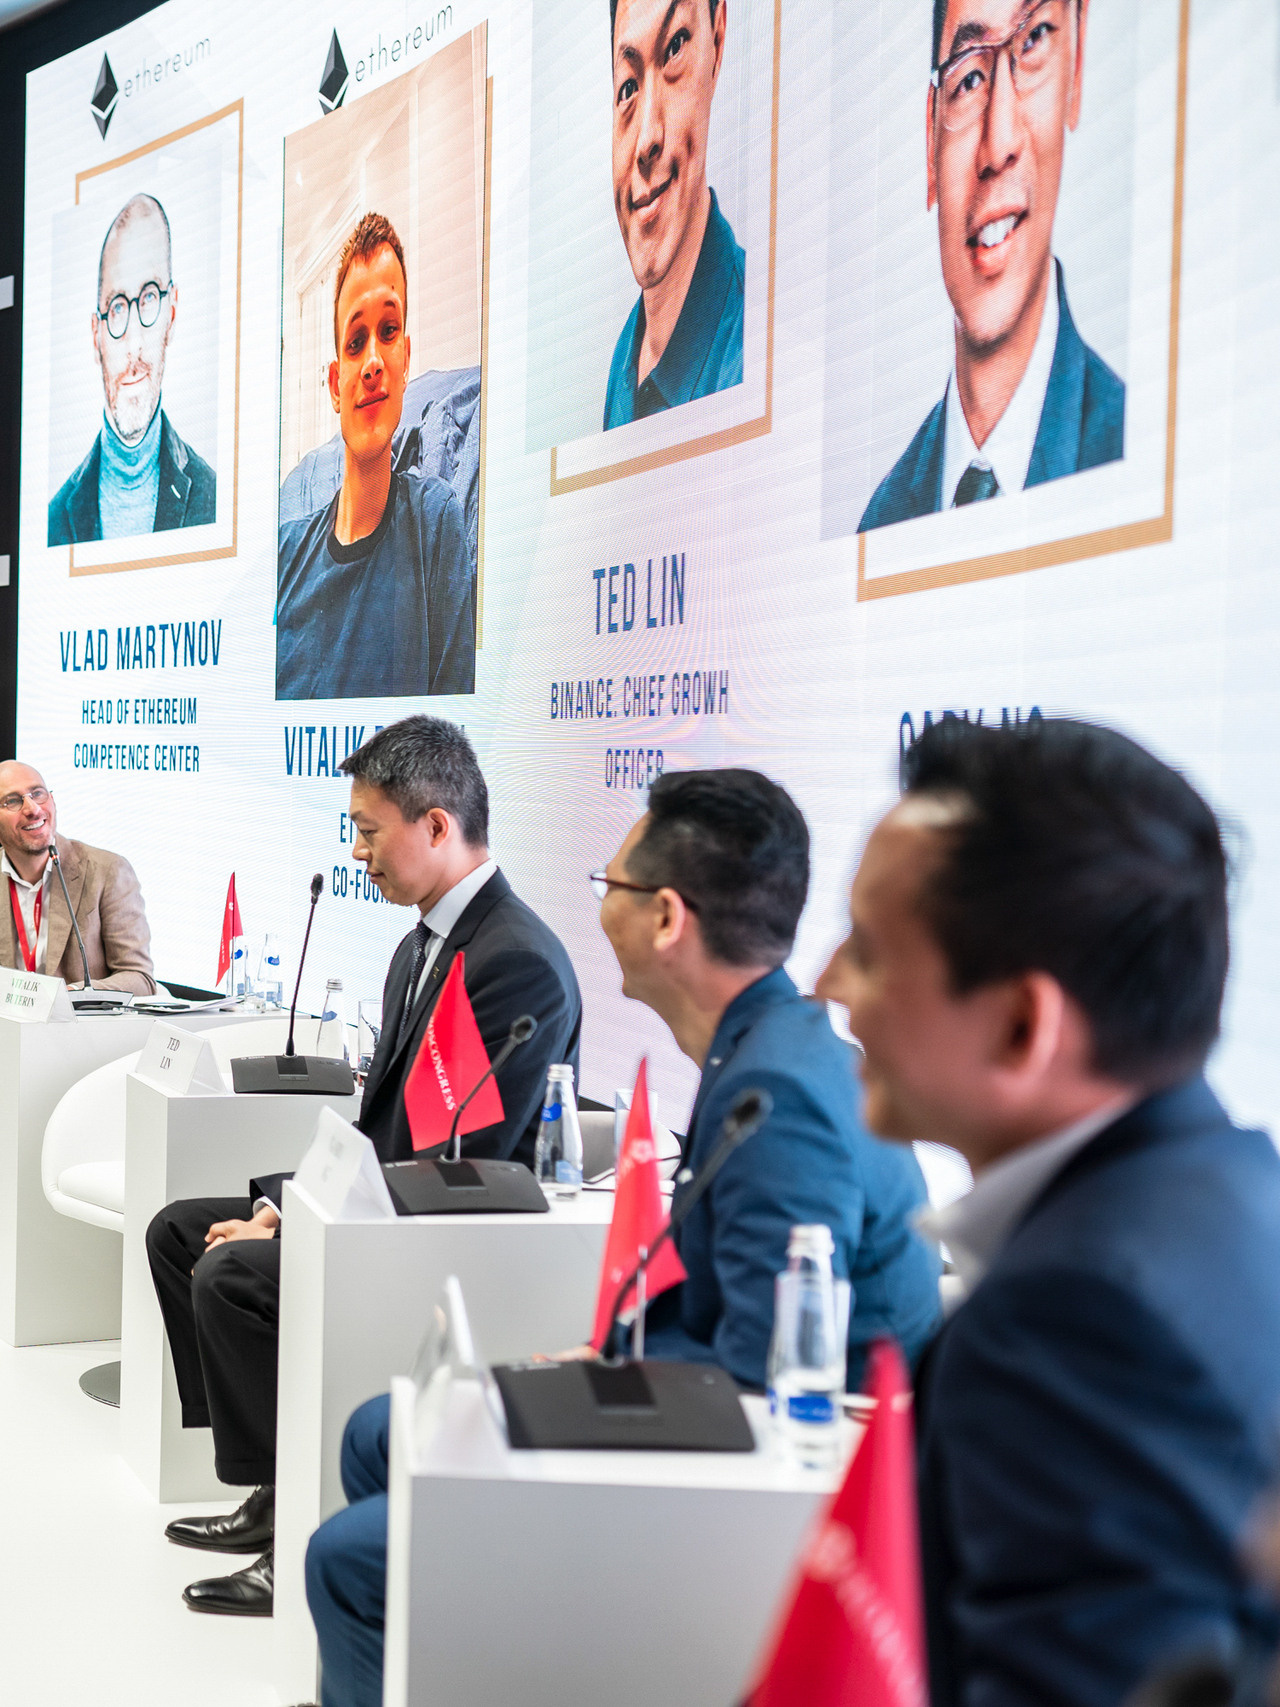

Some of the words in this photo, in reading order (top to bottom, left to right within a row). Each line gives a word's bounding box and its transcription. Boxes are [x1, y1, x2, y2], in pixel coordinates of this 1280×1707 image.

[355, 4, 453, 83] ethereum
[124, 37, 211, 97] ethereum
[593, 562, 636, 635] TED
[646, 552, 685, 628] LIN
[60, 628, 108, 672] VLAD
[116, 619, 222, 670] MARTYNOV
[623, 674, 665, 717] CHIEF
[672, 670, 729, 716] GROWH
[82, 699, 112, 724] HEAD
[116, 699, 130, 724] OF
[134, 697, 197, 725] ETHEREUM
[74, 743, 149, 770] COMPETENCE
[154, 744, 200, 772] CENTER
[11, 977, 41, 992] VITALIK
[5, 993, 35, 1007] BUTERIN
[167, 1037, 180, 1052] TED
[160, 1056, 172, 1070] LIN
